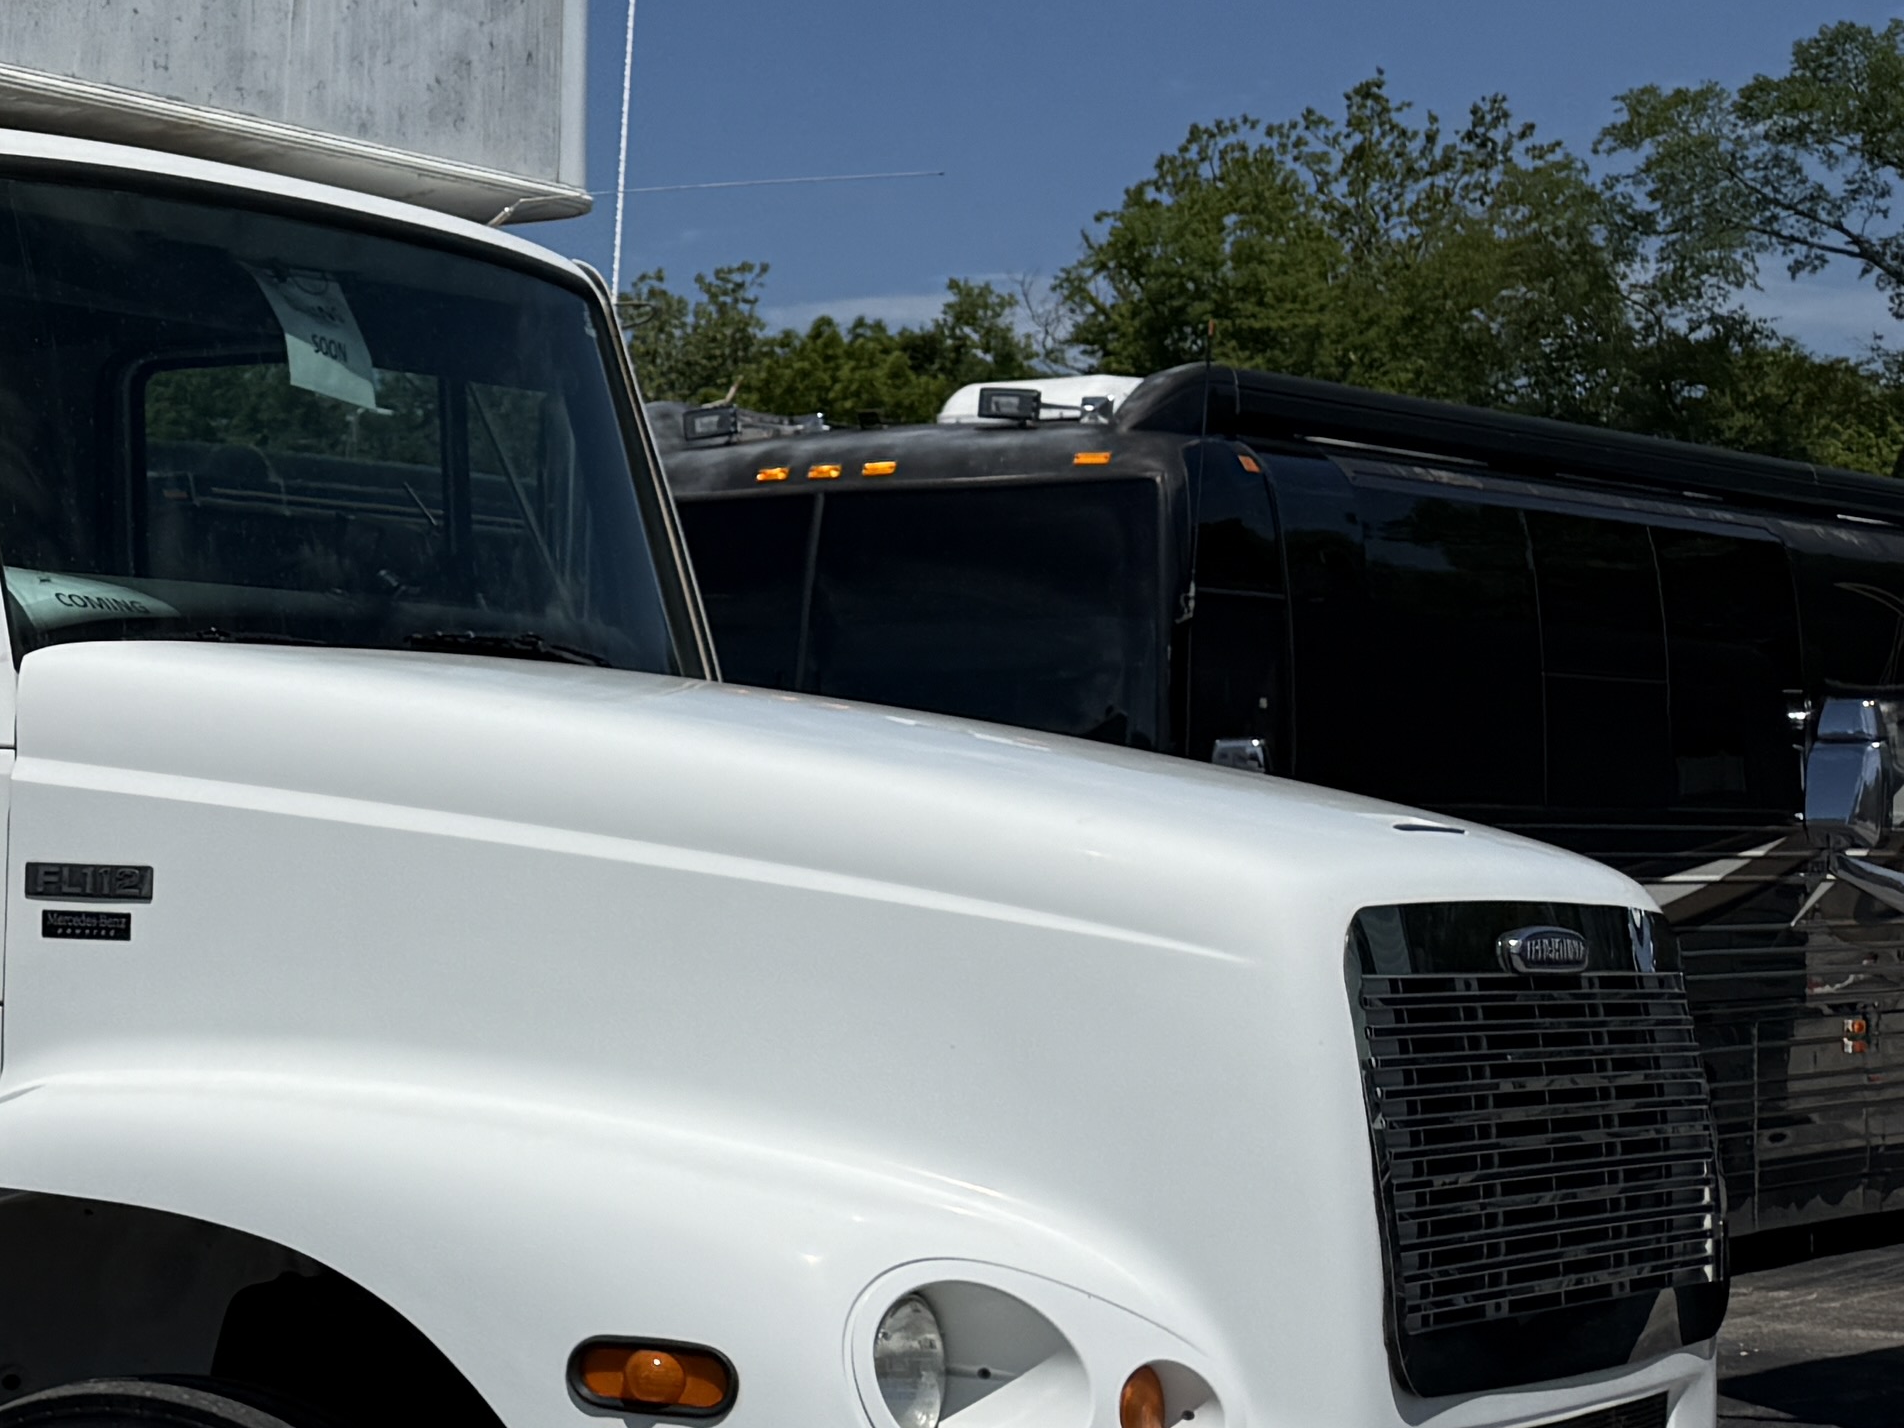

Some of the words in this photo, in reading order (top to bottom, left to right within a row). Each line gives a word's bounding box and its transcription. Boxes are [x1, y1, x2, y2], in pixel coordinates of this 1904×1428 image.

[312, 334, 348, 364] SOON
[55, 592, 152, 614] COMING
[36, 865, 141, 896] FL112
